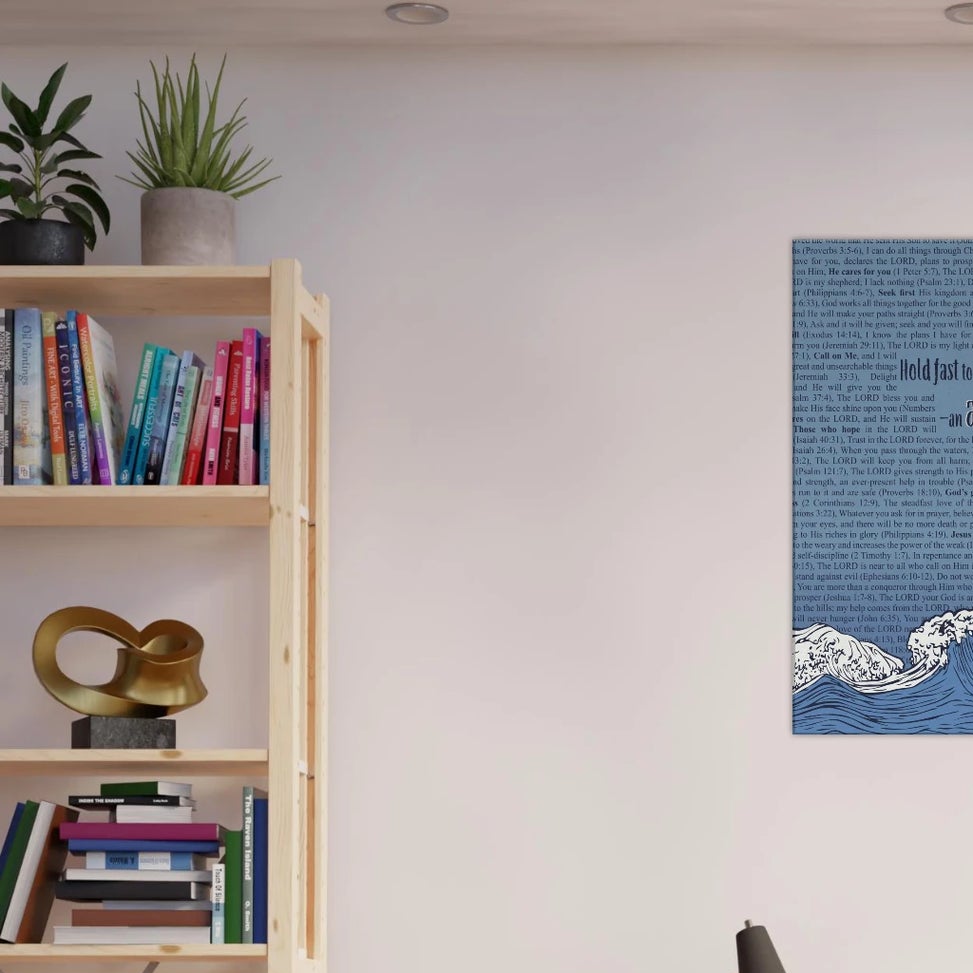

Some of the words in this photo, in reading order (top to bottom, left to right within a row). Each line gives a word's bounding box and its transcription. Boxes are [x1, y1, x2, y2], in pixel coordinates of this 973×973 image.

[934, 289, 968, 299] kingdom
[22, 325, 32, 339] Oil
[19, 343, 32, 386] Paintings
[80, 327, 92, 373] Watercolor
[87, 376, 97, 411] Portraits
[900, 358, 930, 381] Hold
[933, 357, 959, 385] fast
[962, 365, 972, 381] to
[59, 344, 73, 407] ICONIC
[842, 425, 861, 435] hope
[878, 457, 896, 466] keep
[859, 530, 879, 539] glory
